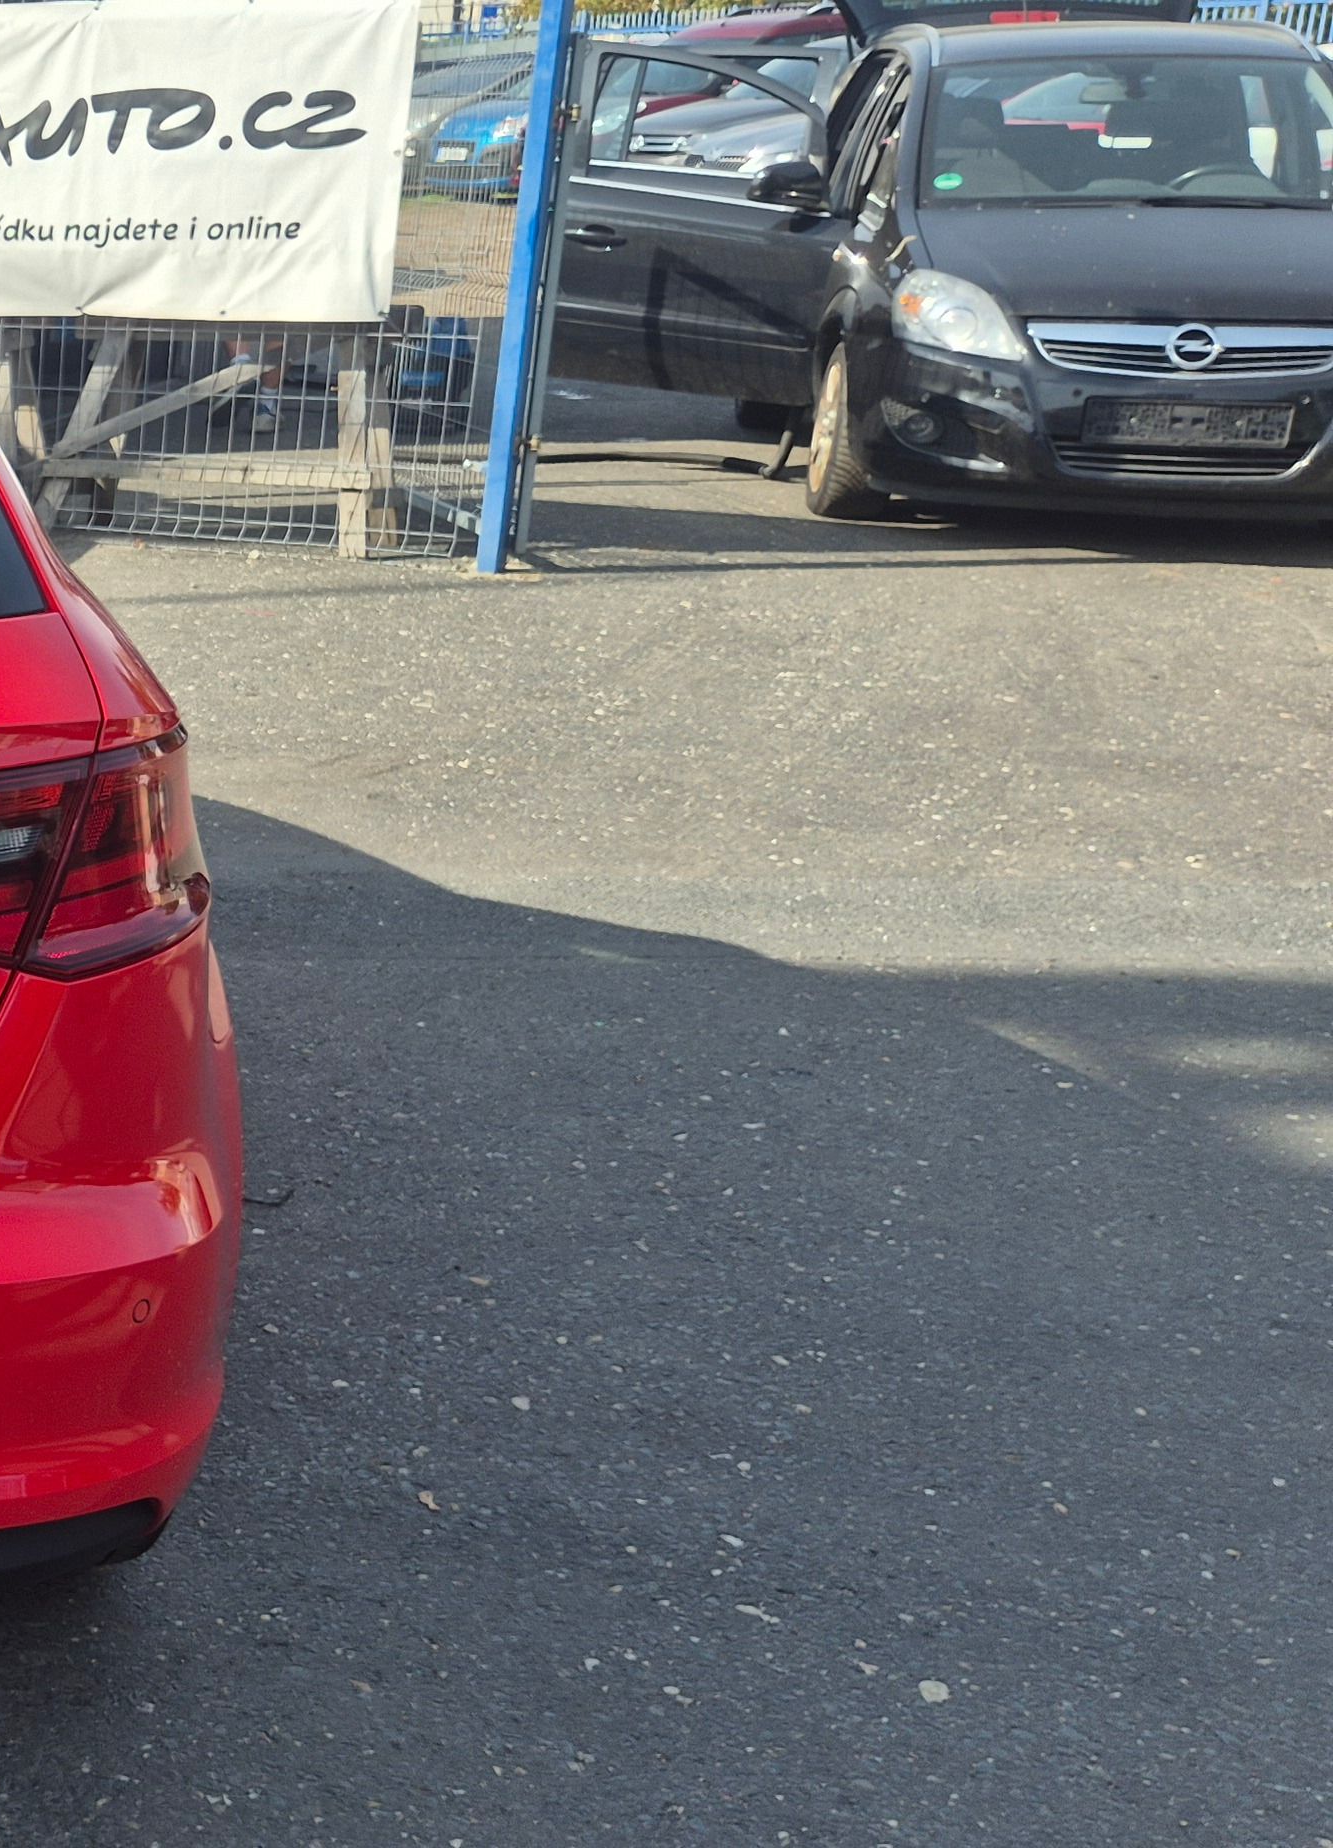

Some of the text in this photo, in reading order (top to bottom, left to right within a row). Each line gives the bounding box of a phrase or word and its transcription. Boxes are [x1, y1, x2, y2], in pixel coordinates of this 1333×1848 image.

[64, 218, 177, 248] najdete
[189, 217, 197, 240] i
[207, 216, 300, 240] online
